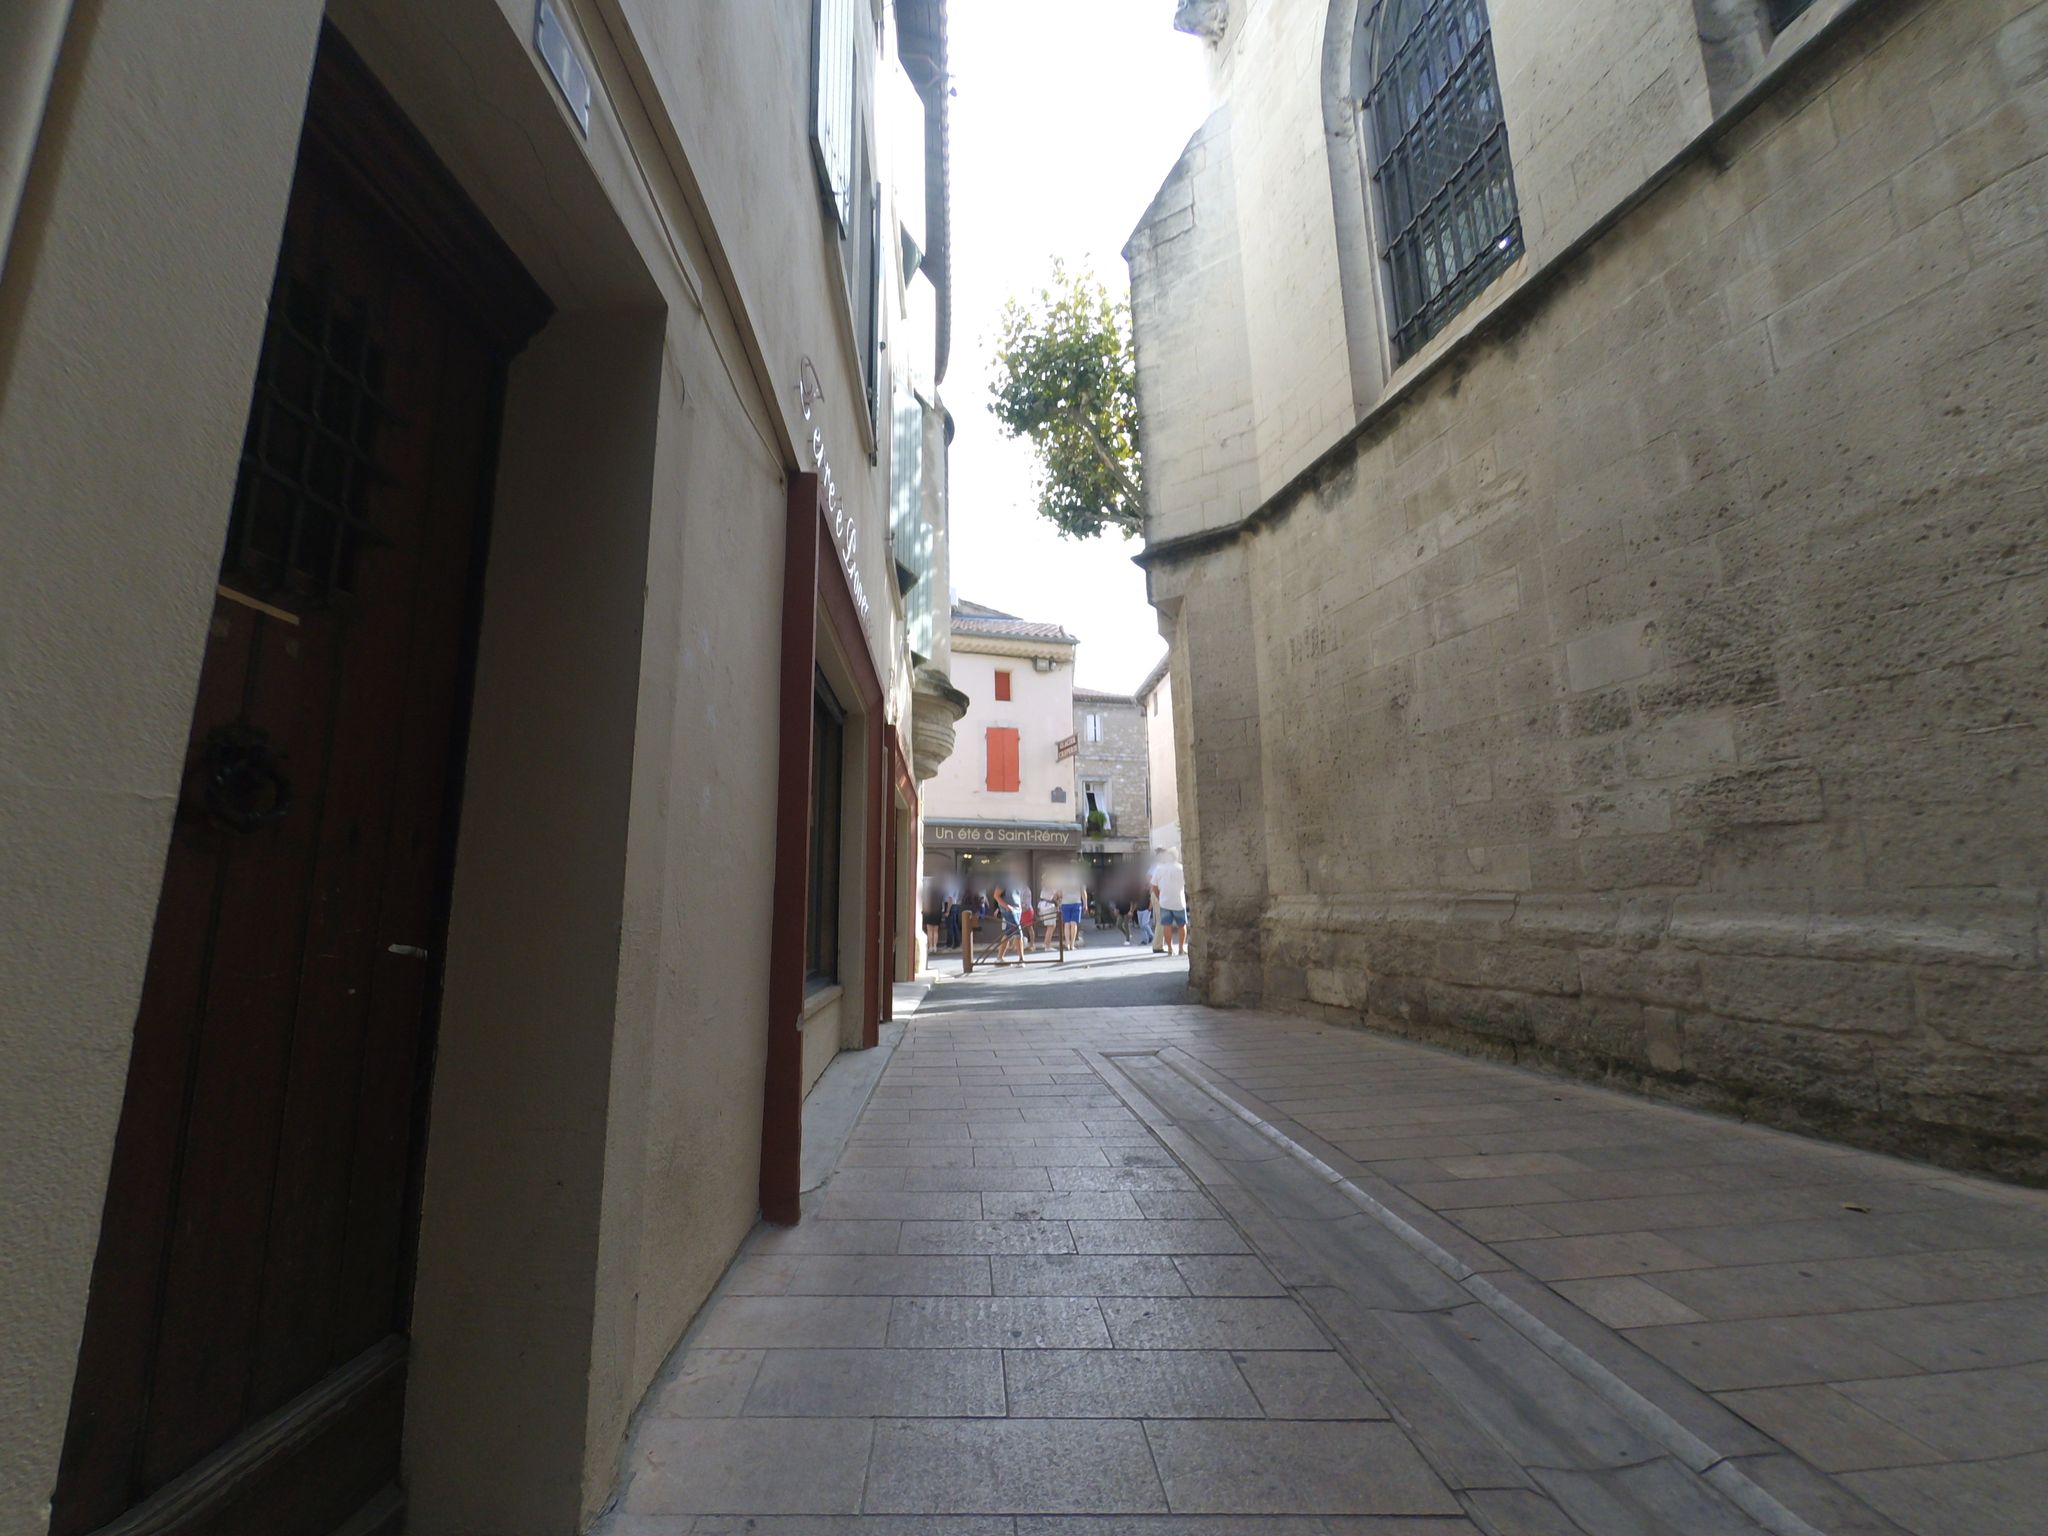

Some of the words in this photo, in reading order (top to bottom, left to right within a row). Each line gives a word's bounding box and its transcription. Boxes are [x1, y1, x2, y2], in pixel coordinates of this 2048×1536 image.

[935, 827, 953, 840] Un
[957, 826, 981, 840] été
[984, 828, 994, 841] à
[998, 828, 1069, 844] Saint-Rémy
